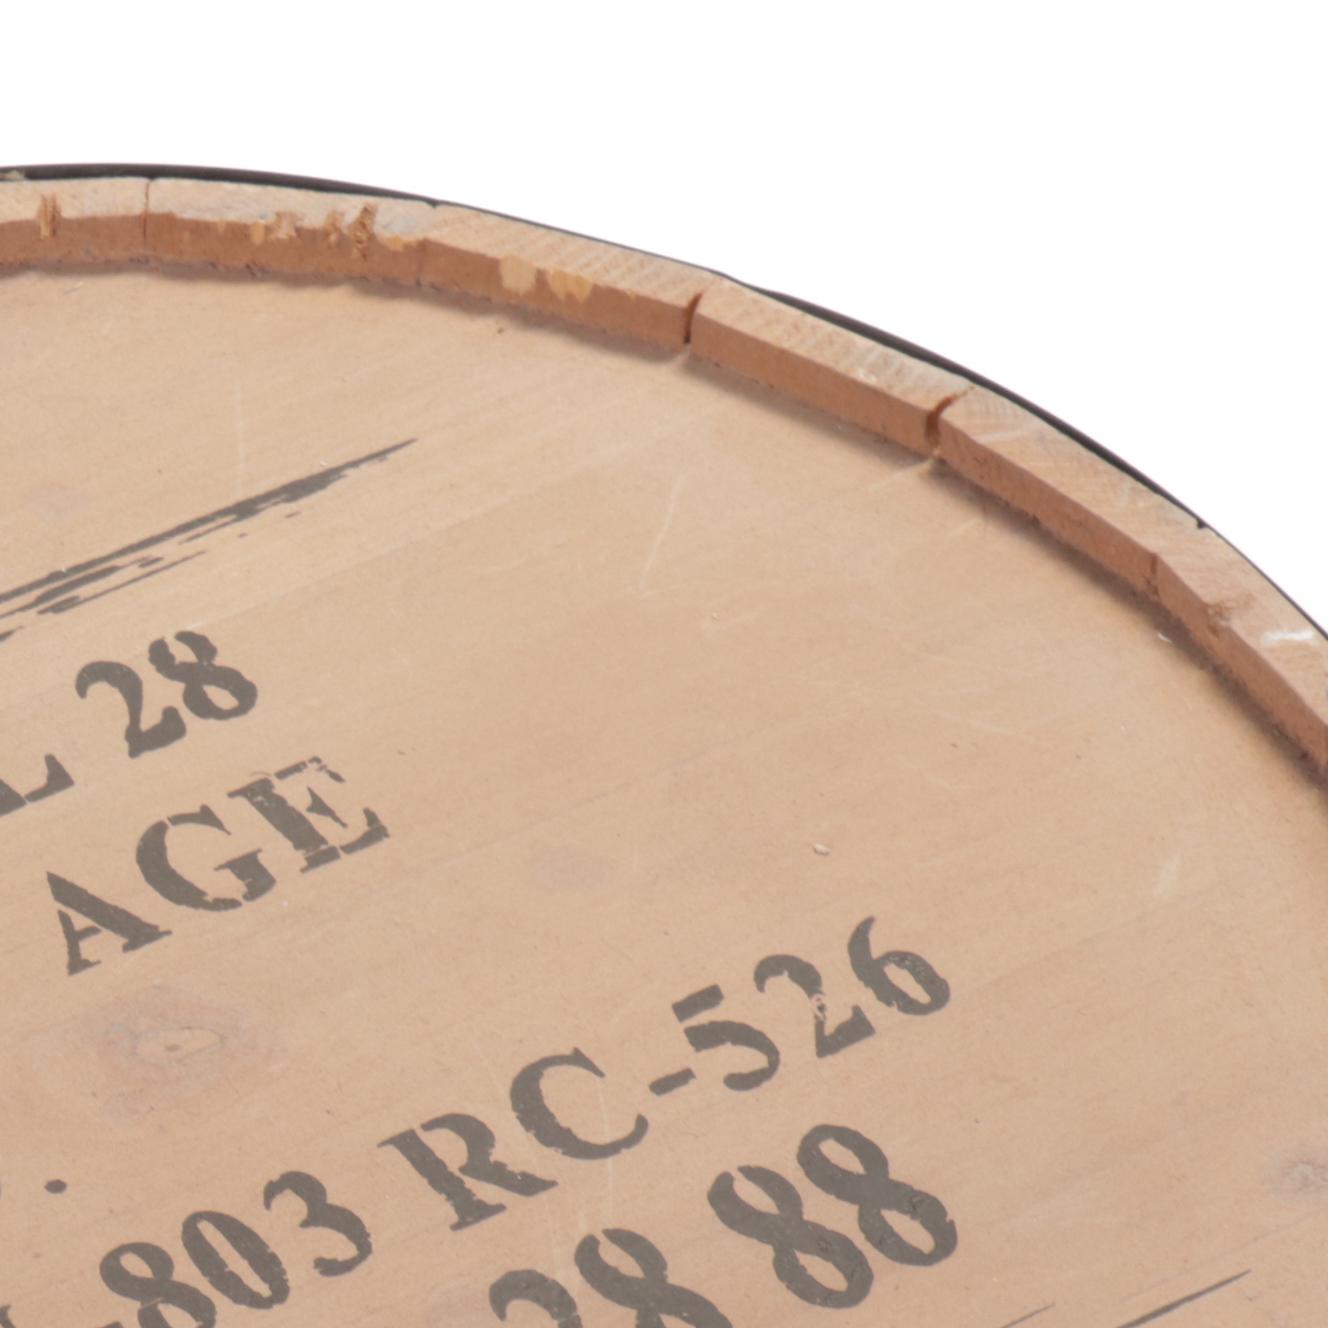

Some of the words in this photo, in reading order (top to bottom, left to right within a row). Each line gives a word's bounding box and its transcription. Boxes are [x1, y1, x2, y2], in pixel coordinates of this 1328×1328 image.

[75, 631, 258, 758] 28
[46, 756, 390, 975] AGE
[377, 916, 950, 1231] RC-526
[707, 1124, 958, 1309] 88
